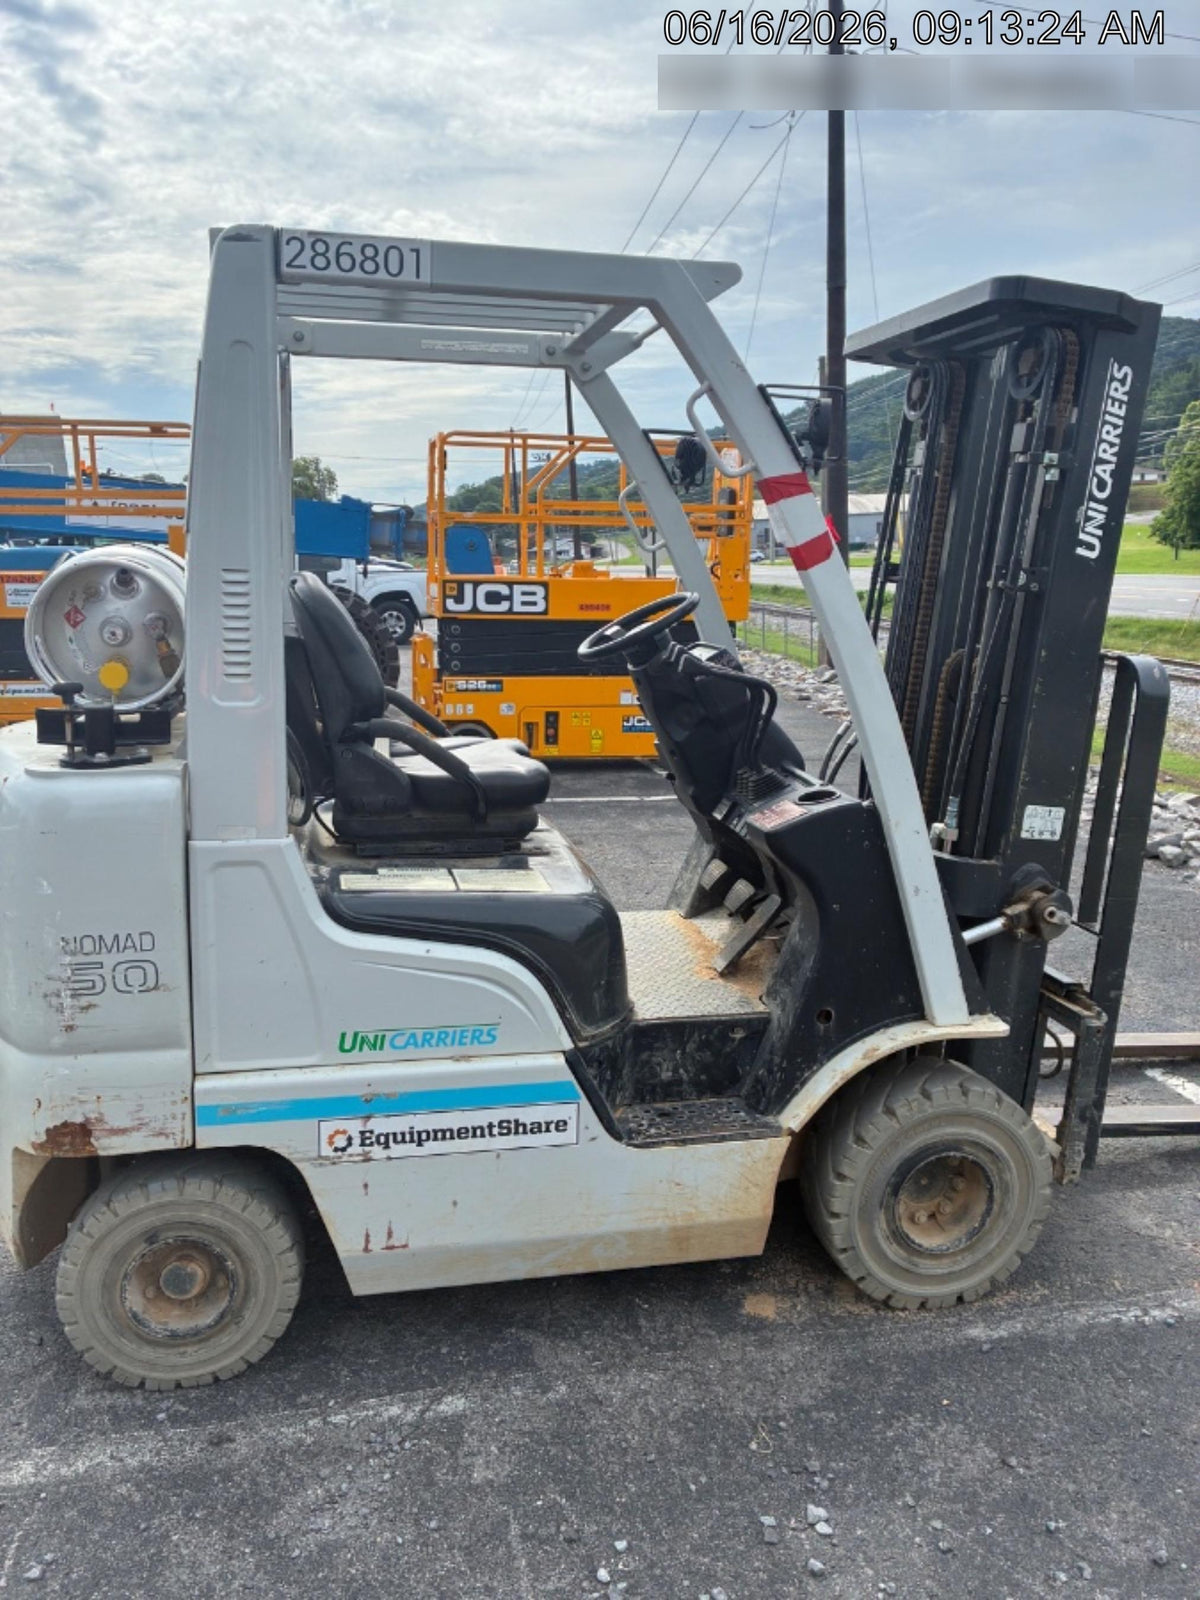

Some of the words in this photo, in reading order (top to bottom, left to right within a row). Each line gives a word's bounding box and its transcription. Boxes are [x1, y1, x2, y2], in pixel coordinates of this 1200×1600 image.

[284, 235, 421, 280] 286801
[1075, 361, 1133, 560] UNICARRIERS
[445, 582, 547, 613] JCB
[61, 931, 156, 956] NOMAD
[60, 959, 160, 998] 50
[358, 1118, 569, 1149] EquipmentShare
